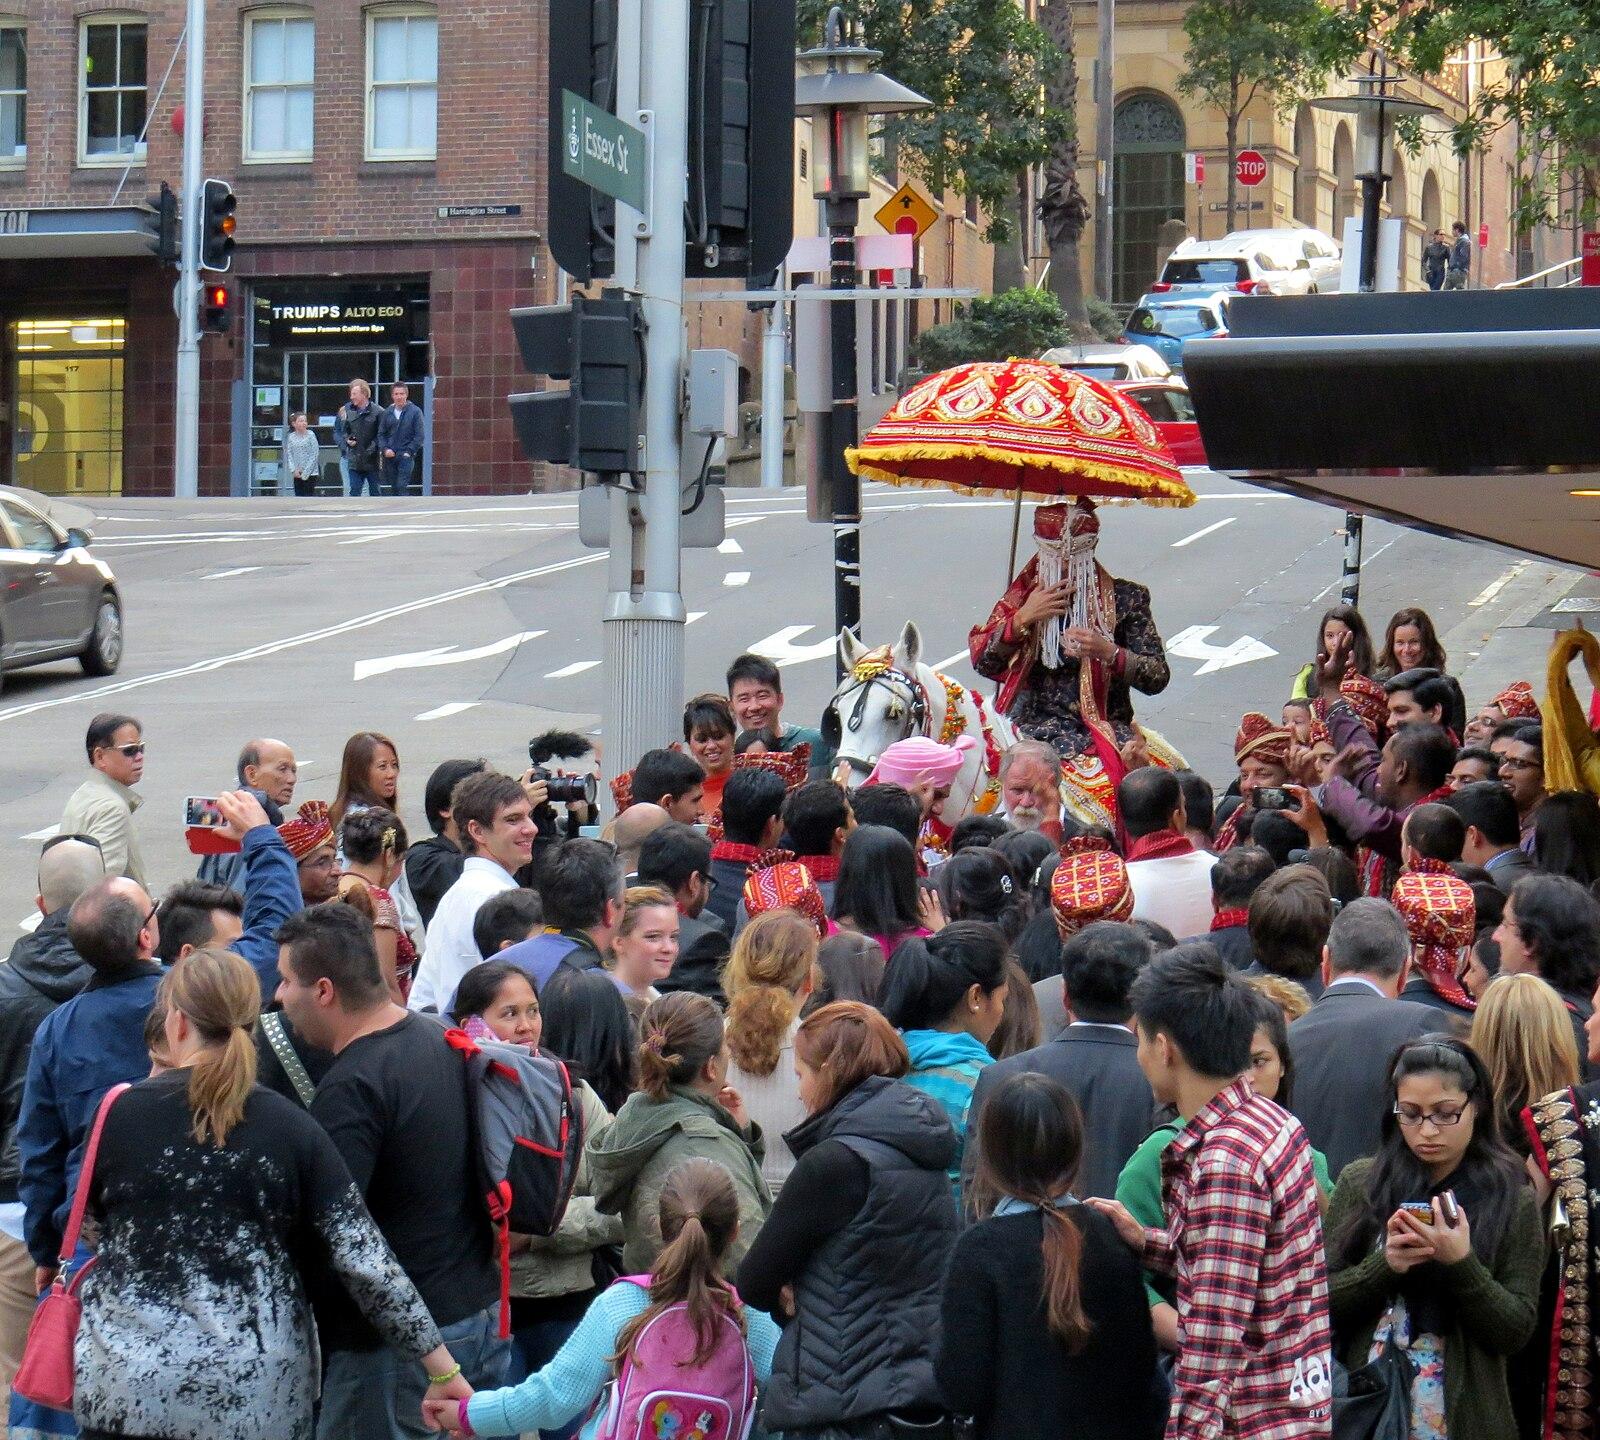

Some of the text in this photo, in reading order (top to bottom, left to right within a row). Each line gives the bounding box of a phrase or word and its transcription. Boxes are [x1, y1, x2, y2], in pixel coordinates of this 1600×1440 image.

[585, 116, 629, 174] Essex St
[1236, 161, 1265, 175] STOP
[449, 205, 507, 216] Harrington Street
[273, 305, 404, 320] TRUMPS ALTO EGO
[371, 324, 385, 334] Spa
